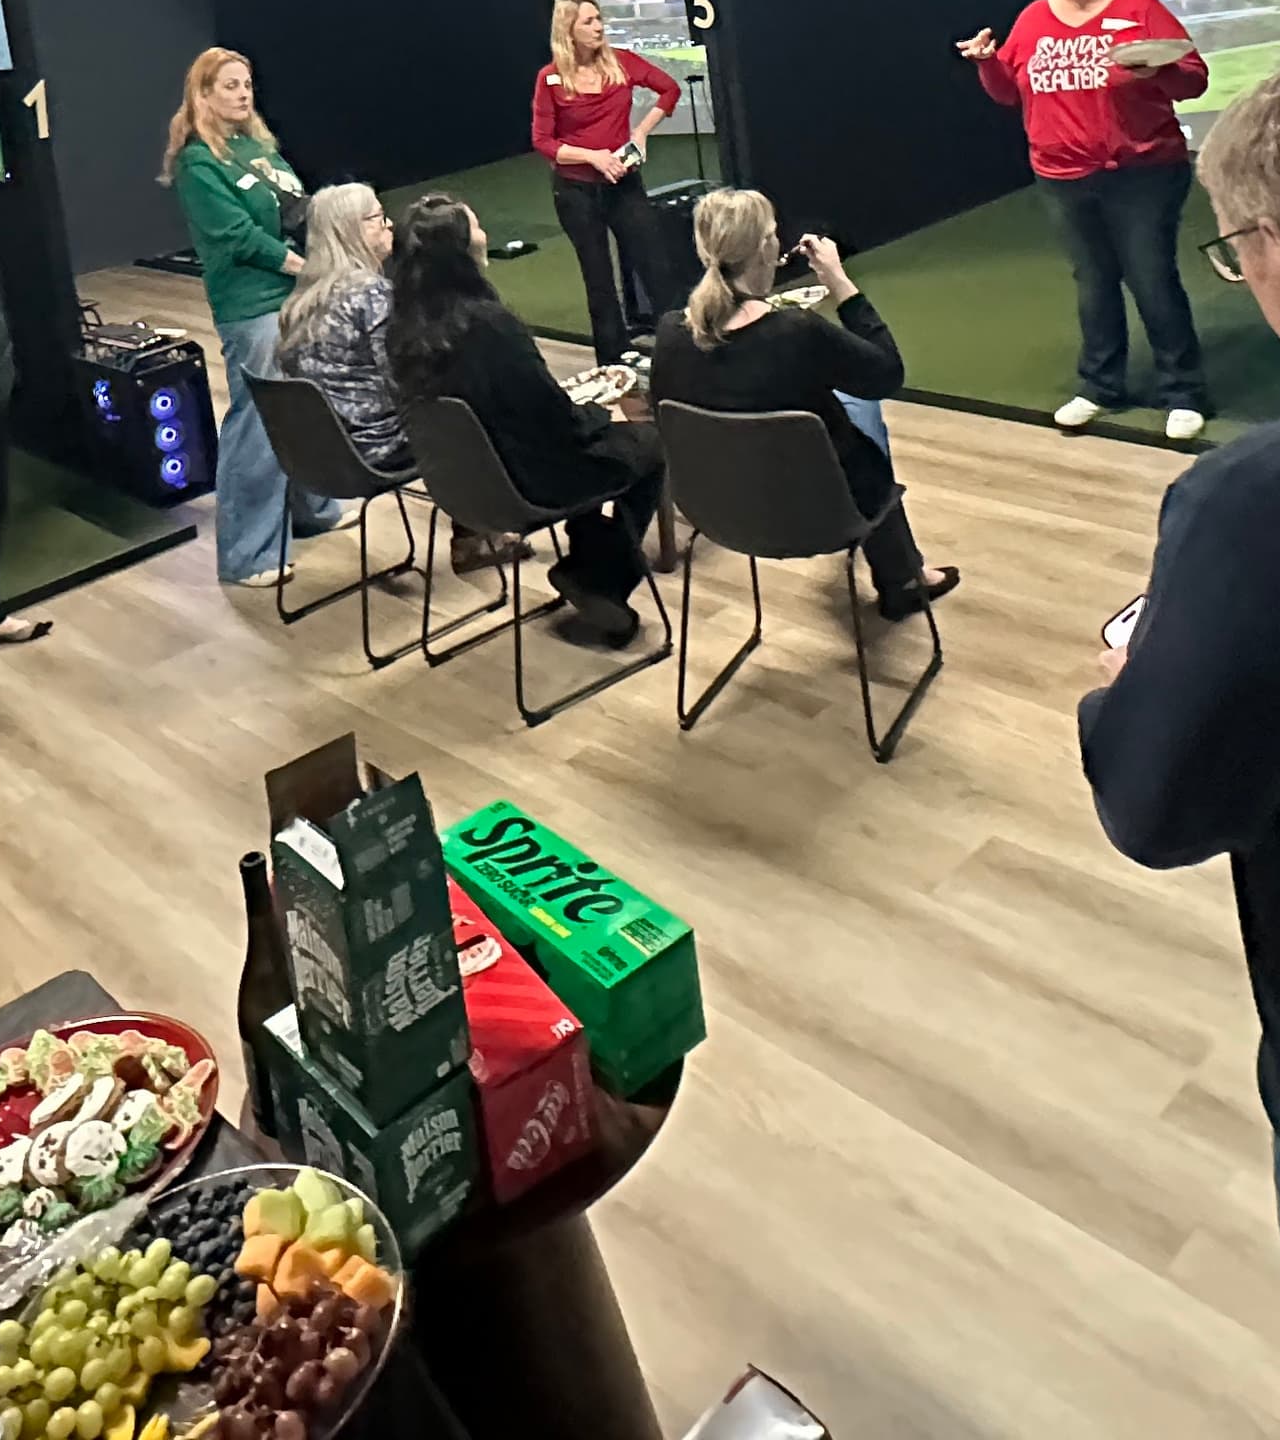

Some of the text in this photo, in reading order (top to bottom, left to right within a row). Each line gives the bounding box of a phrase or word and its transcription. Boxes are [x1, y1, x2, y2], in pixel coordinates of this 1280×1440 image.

[1030, 67, 1109, 94] REALTOR
[22, 79, 50, 139] 1
[459, 817, 624, 924] Sprite
[473, 862, 506, 883] ZERO
